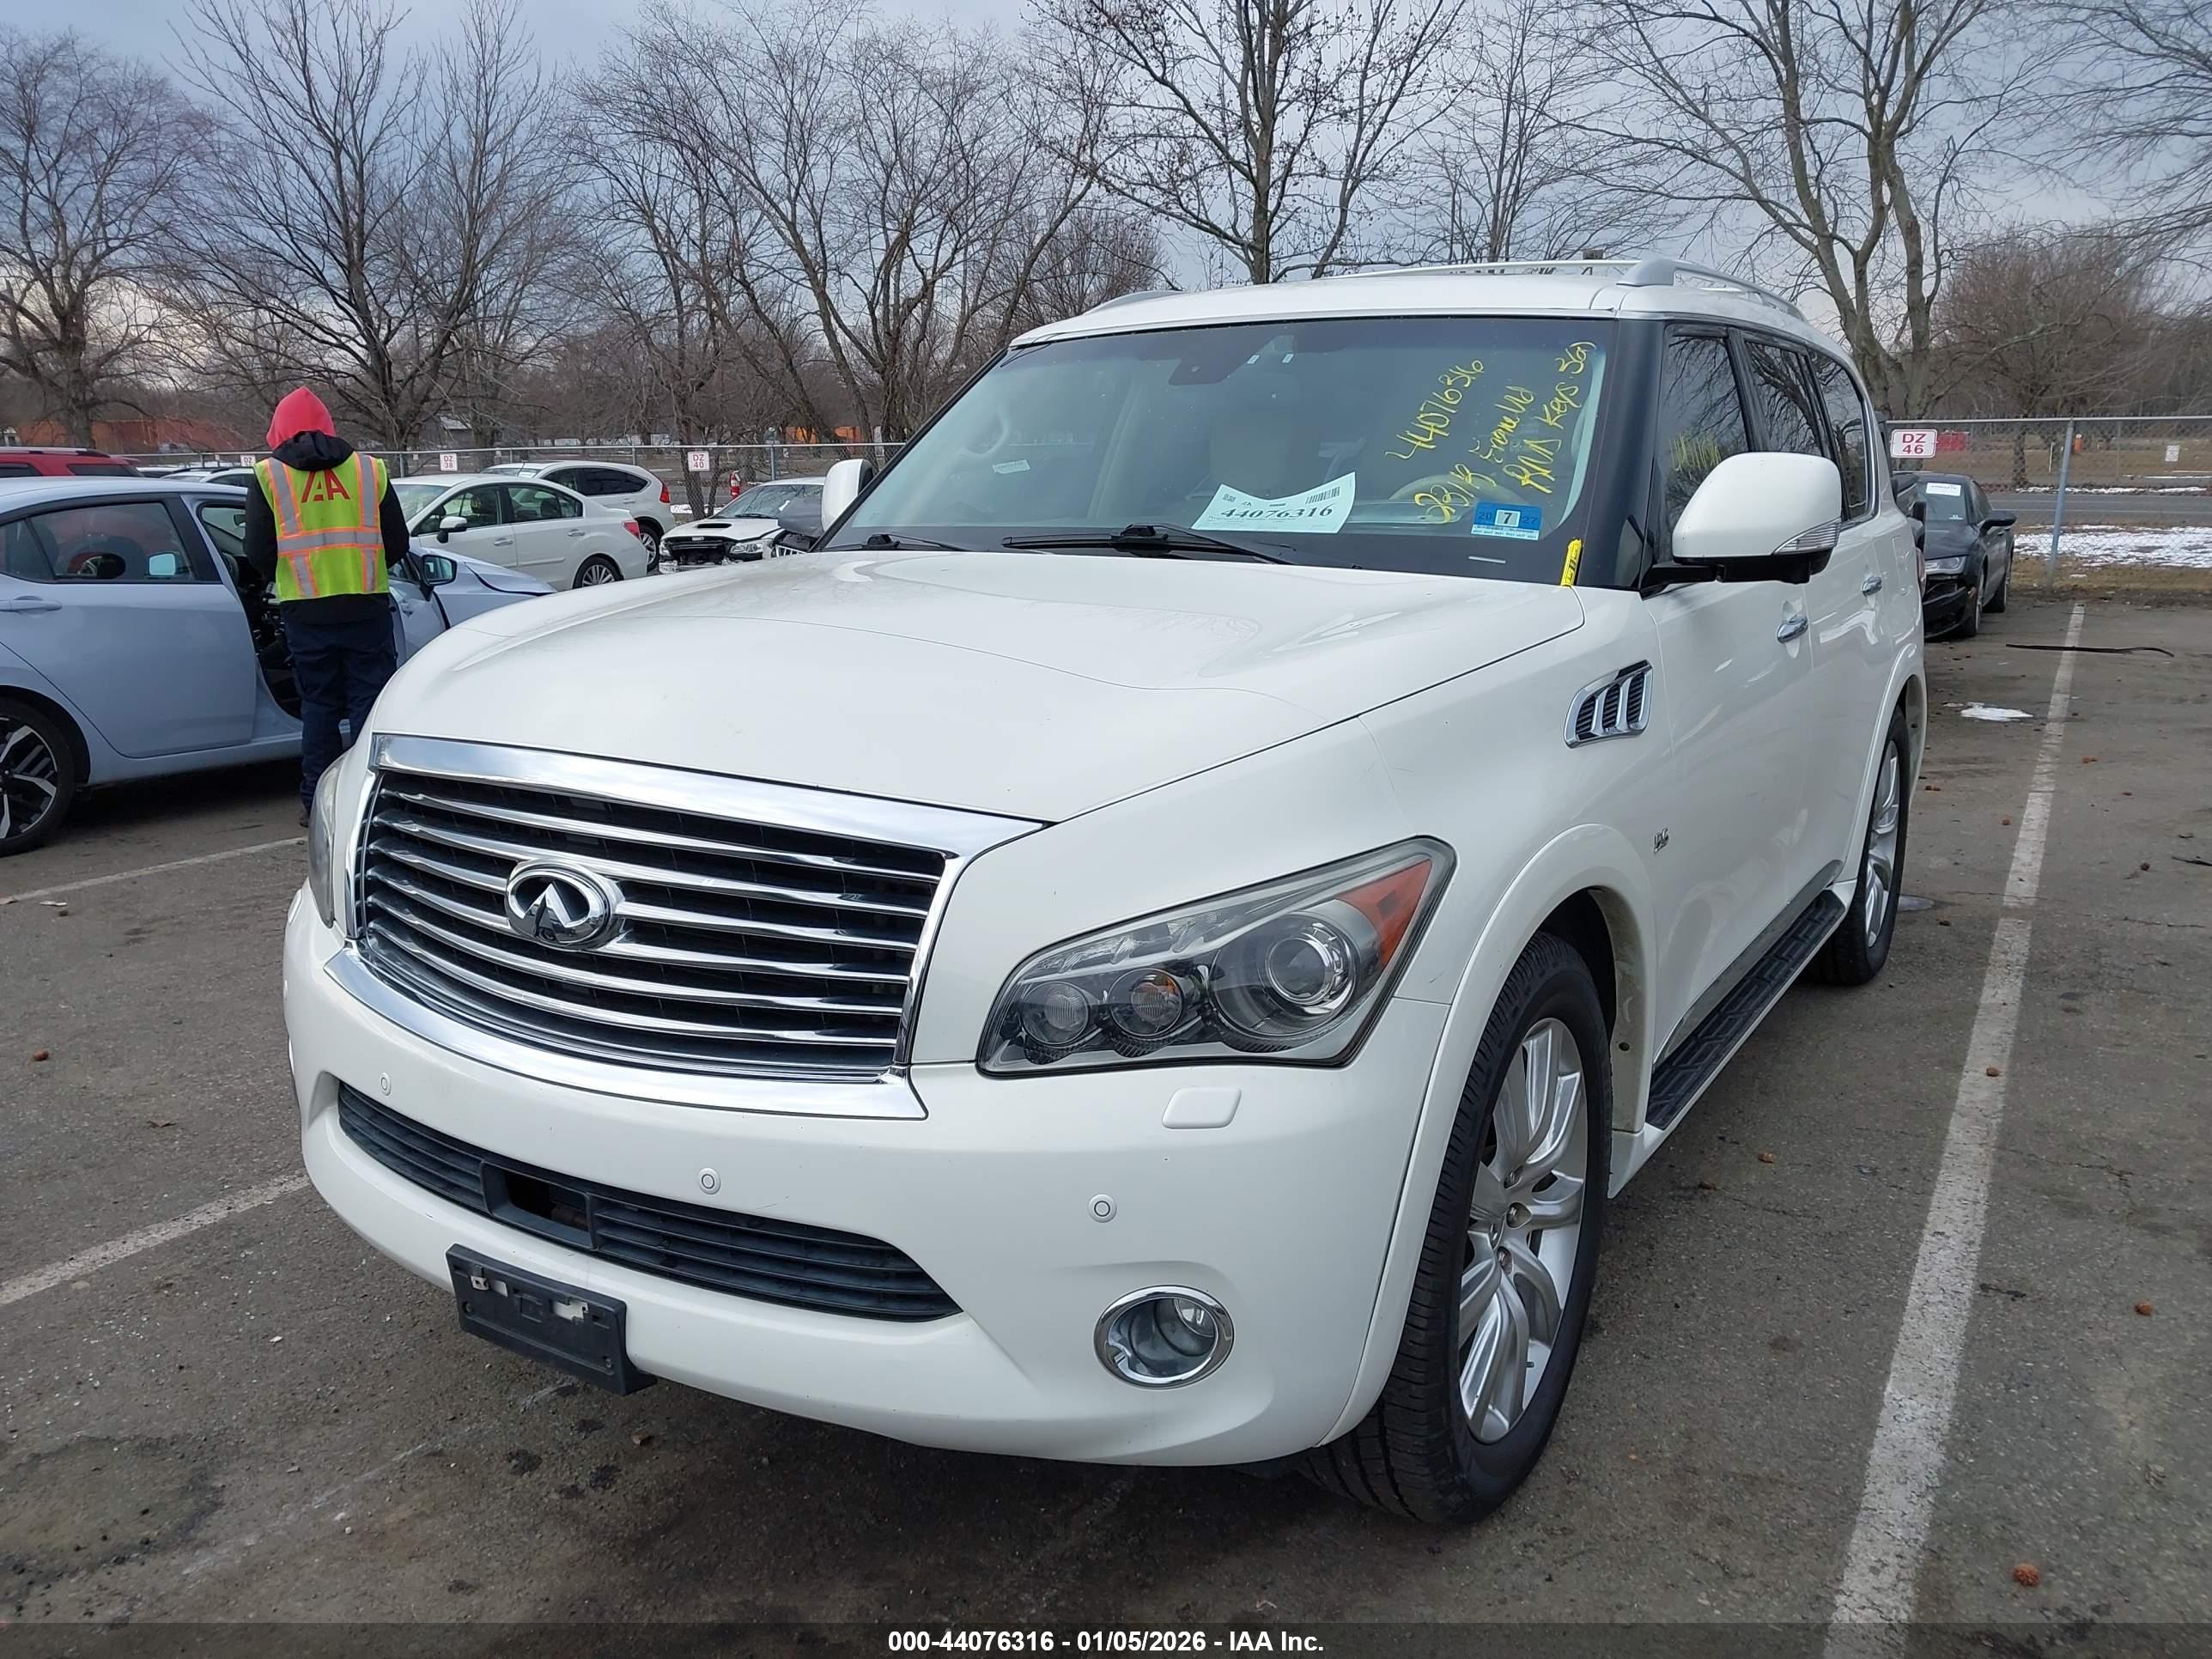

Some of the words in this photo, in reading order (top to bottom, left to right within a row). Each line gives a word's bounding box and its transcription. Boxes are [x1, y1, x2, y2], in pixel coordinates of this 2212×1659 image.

[1902, 433, 1927, 444] DZ
[1902, 445, 1924, 454] 46
[692, 453, 705, 462] DZ
[1220, 503, 1335, 519] 44076316
[1504, 512, 1512, 525] 7
